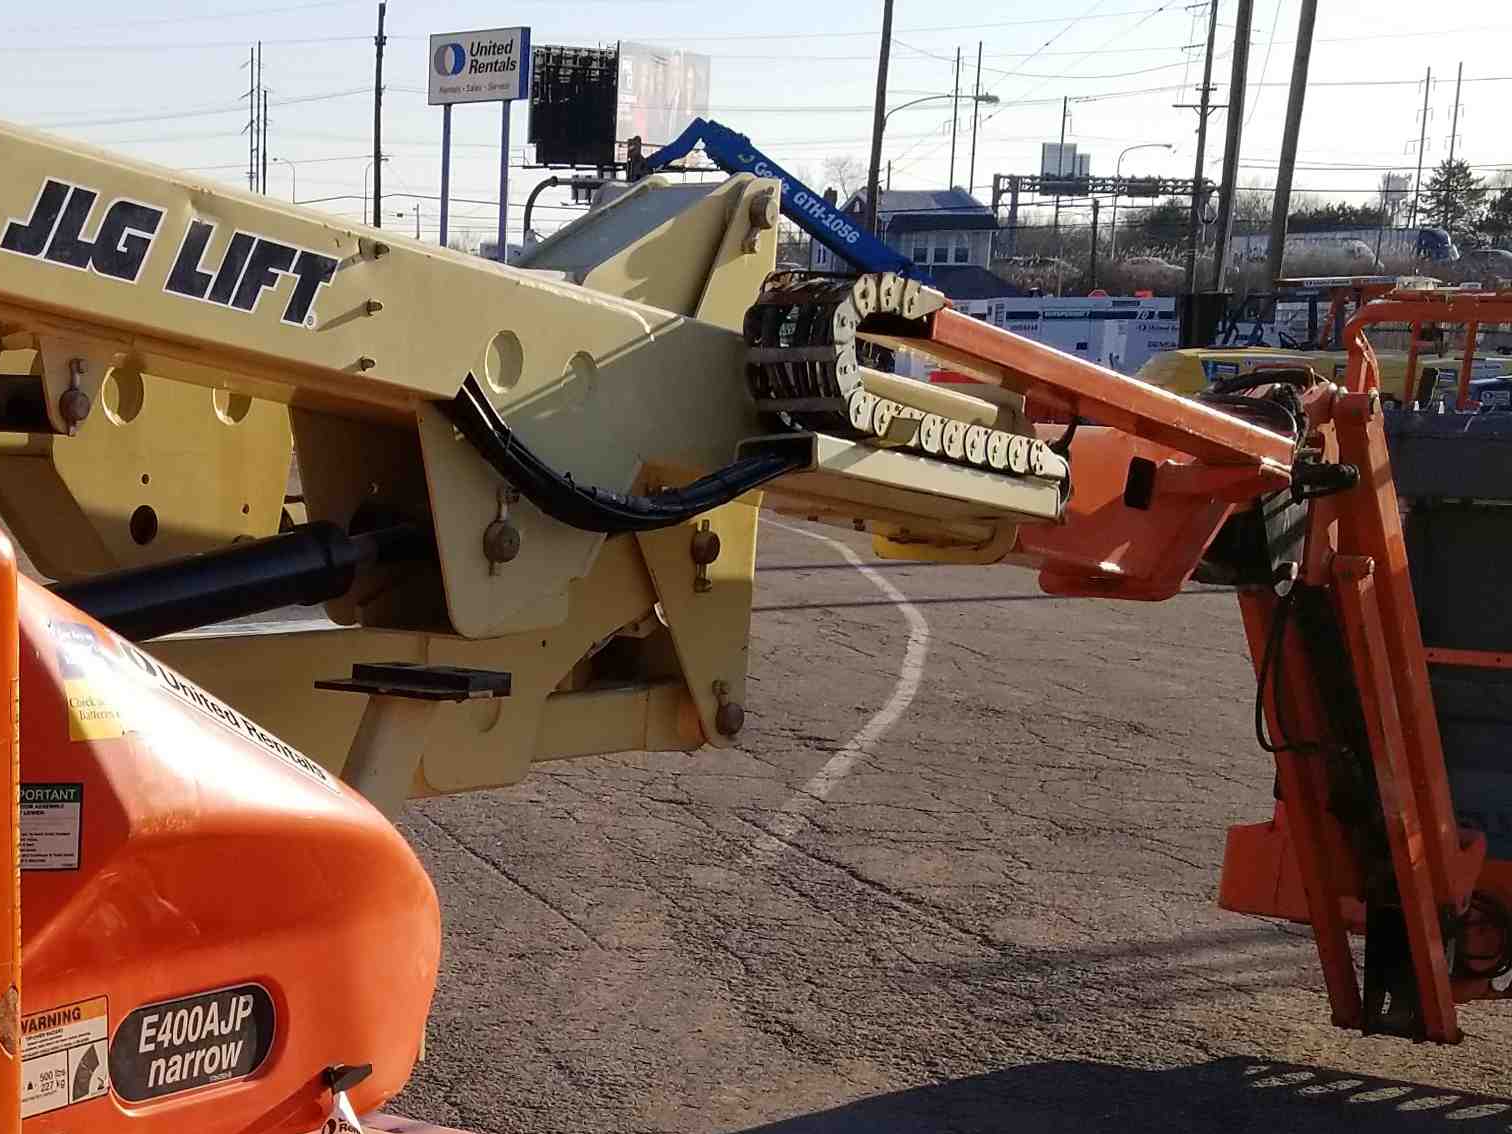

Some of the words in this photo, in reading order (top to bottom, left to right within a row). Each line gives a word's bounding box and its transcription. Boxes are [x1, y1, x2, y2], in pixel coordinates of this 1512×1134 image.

[468, 57, 517, 75] Rentals
[469, 39, 514, 57] United
[793, 191, 860, 244] GTH-1056
[163, 216, 342, 327] LIFT
[156, 664, 241, 729] United
[241, 716, 327, 781] Rentals
[138, 994, 254, 1054] E400AJP
[147, 1039, 243, 1088] narrow
